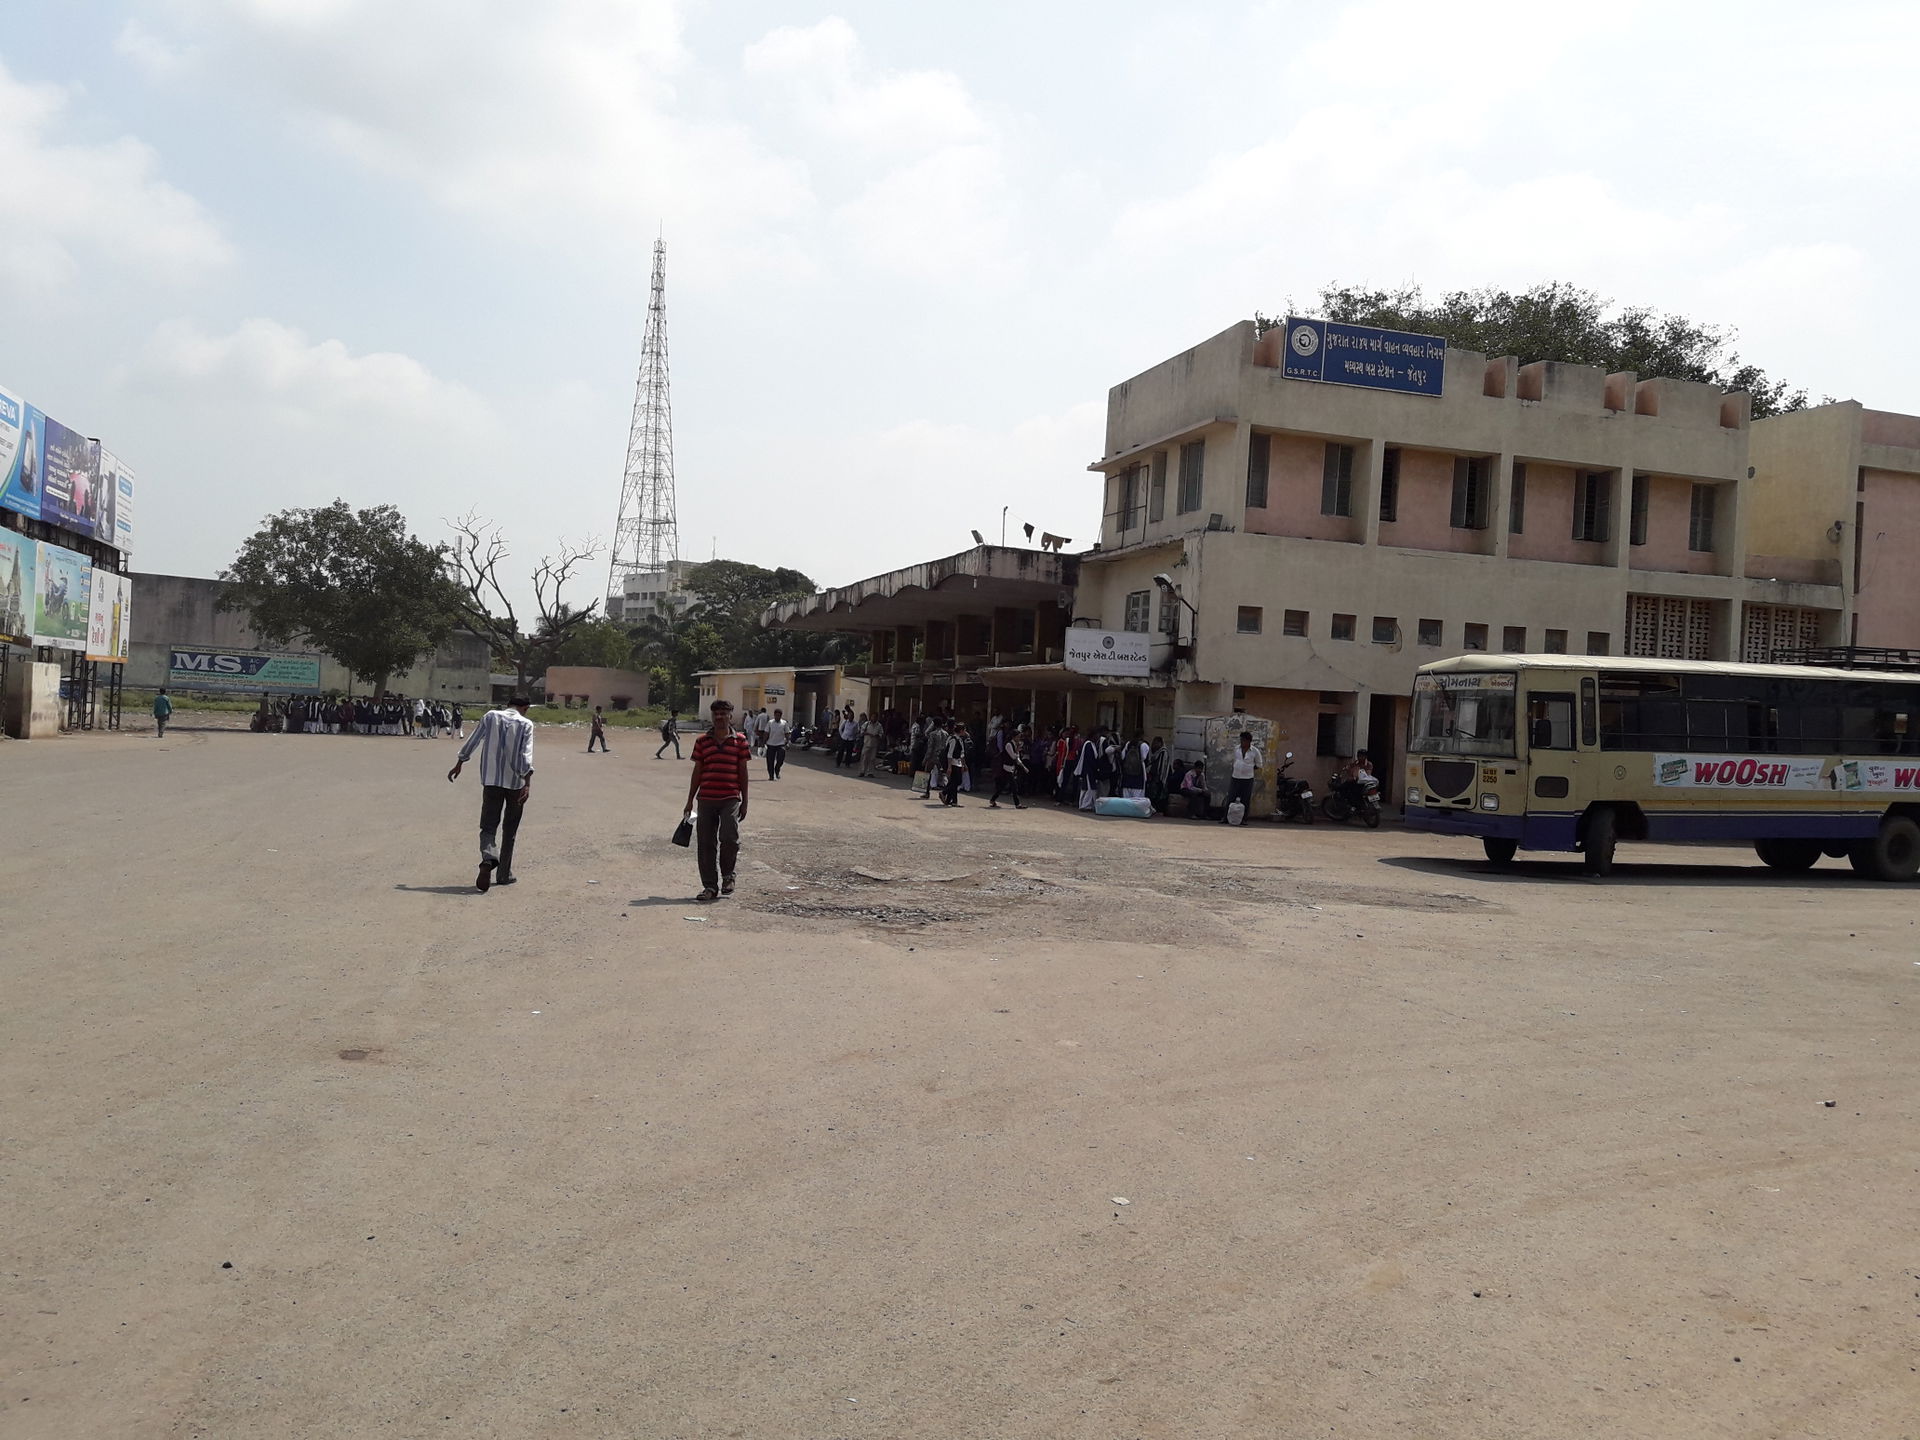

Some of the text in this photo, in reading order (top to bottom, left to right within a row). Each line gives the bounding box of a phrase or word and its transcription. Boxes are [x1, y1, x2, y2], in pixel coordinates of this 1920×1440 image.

[1326, 332, 1349, 350] ગુજરાત
[1384, 342, 1400, 355] વાહન
[1365, 362, 1376, 377] બસ
[1407, 364, 1427, 386] જેતપુર
[0, 401, 16, 422] EVA
[1069, 648, 1091, 662] જેતપુર
[1694, 758, 1788, 786] WOOSH
